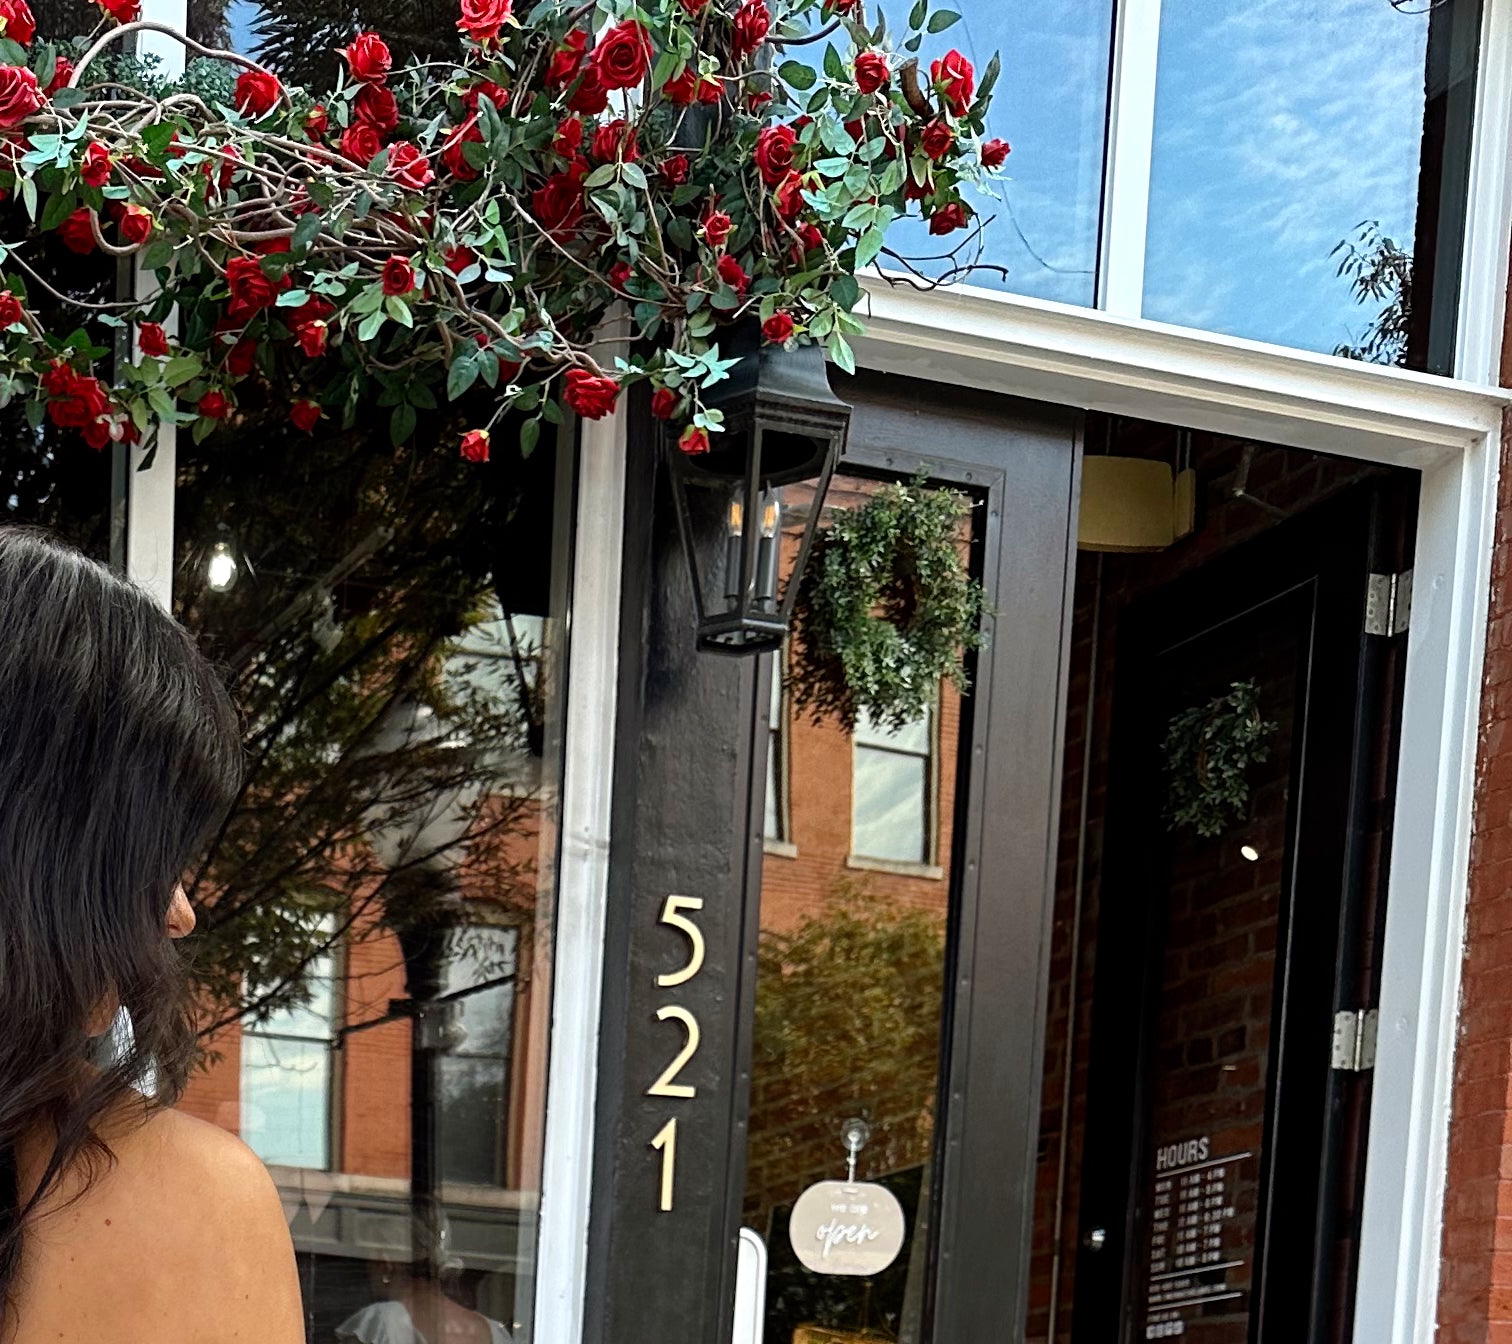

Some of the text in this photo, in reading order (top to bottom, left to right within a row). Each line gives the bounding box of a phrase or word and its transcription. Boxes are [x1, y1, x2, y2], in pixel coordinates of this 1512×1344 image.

[648, 895, 705, 1211] 521
[1156, 1136, 1209, 1170] HOURS
[816, 1218, 880, 1258] open
